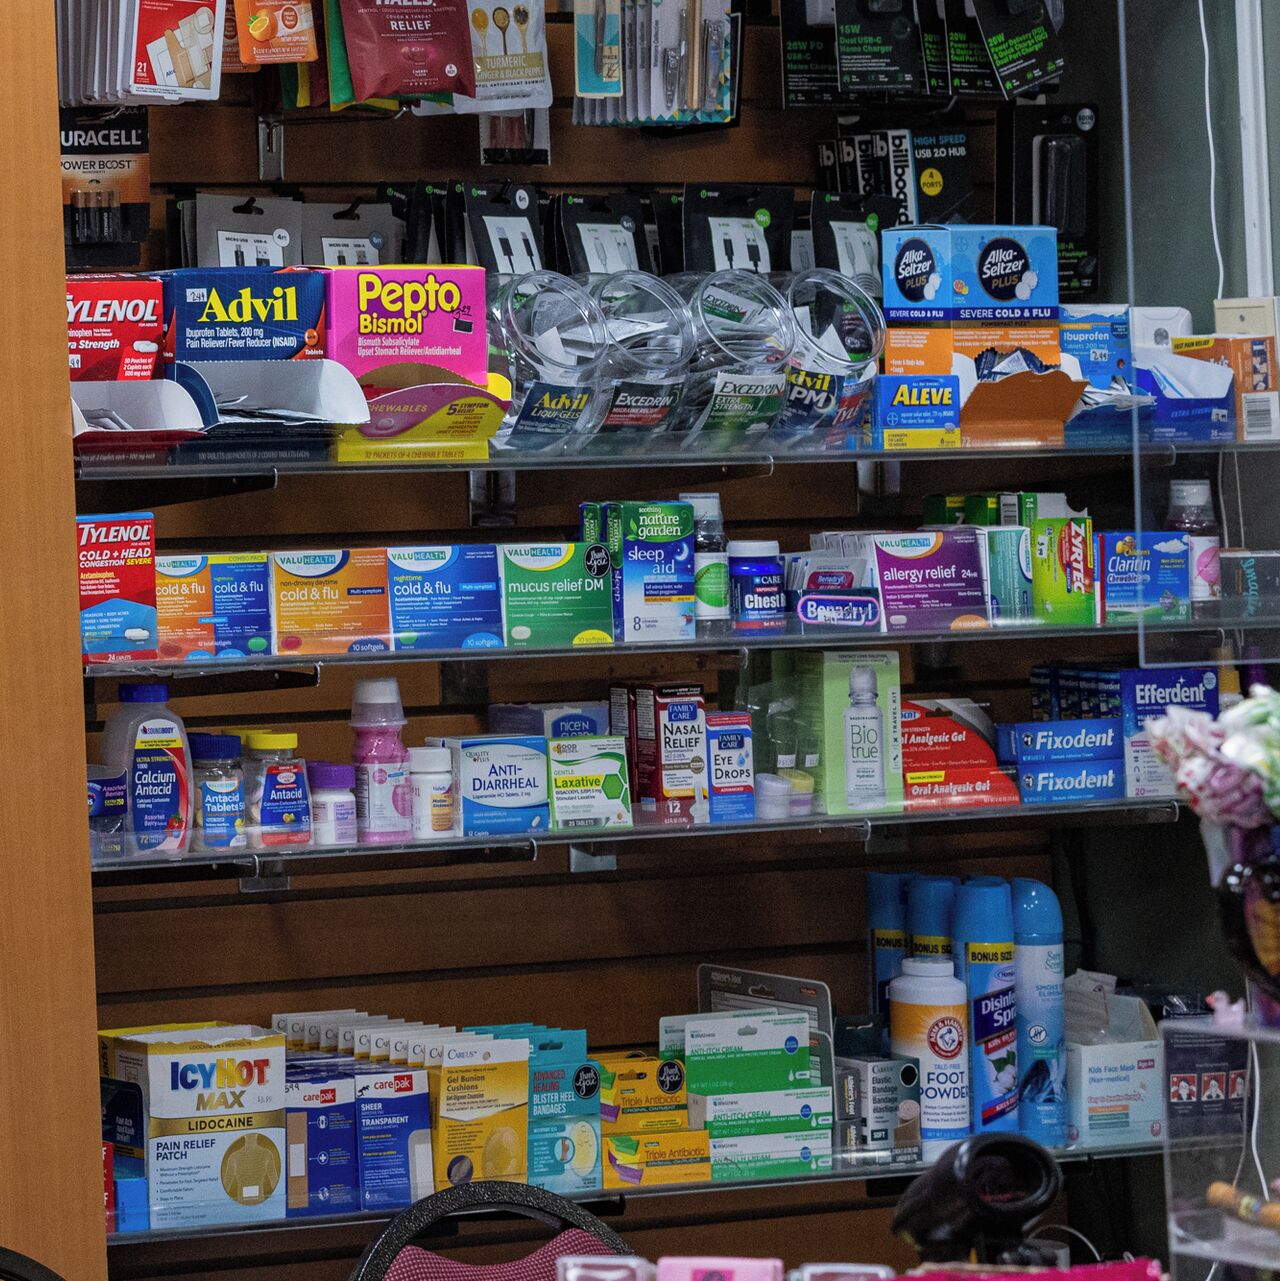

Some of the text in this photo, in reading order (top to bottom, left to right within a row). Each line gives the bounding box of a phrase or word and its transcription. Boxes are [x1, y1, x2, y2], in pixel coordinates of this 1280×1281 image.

[391, 21, 431, 30] RELIEF
[137, 63, 146, 71] 21
[898, 261, 932, 278] Seltzer
[982, 259, 1024, 277] Seltzer
[992, 276, 1019, 288] PLUS
[358, 273, 461, 318] Pepto
[198, 287, 297, 322] Advil
[960, 308, 1050, 318] SEVERE COLD & FLU
[359, 313, 423, 334] Bismol
[1064, 332, 1109, 342] Ibuprofen
[720, 382, 784, 394] EXCEDRIN
[537, 393, 589, 409] Advil
[791, 388, 828, 407] PM
[893, 385, 952, 406] ALEVE
[640, 514, 679, 525] nature
[79, 524, 150, 546] TYLENOL
[639, 526, 681, 537] garden
[628, 547, 663, 562] sleep
[653, 562, 675, 574] aid
[884, 565, 956, 582] allergy relief
[214, 582, 263, 593] cold & flu
[394, 581, 451, 595] cold & flu
[508, 578, 603, 592] mucus relief DM
[280, 587, 339, 601] cold & flu
[745, 594, 778, 609] Chest
[633, 617, 641, 631] 8
[1136, 683, 1206, 704] Efferdent
[663, 723, 703, 735] NASAL
[850, 725, 877, 744] Bio
[664, 737, 700, 748] RELIEF
[1036, 729, 1114, 750] Fixodent
[852, 746, 878, 759] true
[714, 754, 733, 766] EYE
[489, 763, 522, 777] ANTI-
[715, 768, 750, 779] DROPS
[135, 773, 175, 783] Calcium
[555, 778, 600, 788] Laxative
[1038, 771, 1115, 791] Fixodent
[136, 784, 171, 795] Antacid
[472, 778, 539, 791] DIARRHEAL
[205, 794, 239, 802] Antacid
[270, 789, 302, 799] Antacid
[205, 803, 238, 811] Tablets
[971, 951, 1012, 961] BONUS SIZE
[927, 1072, 964, 1085] FOOT
[196, 1091, 246, 1111] MAX
[533, 1092, 575, 1103] BLISTER HEEL
[361, 1103, 382, 1111] SHEER
[533, 1104, 566, 1114] BANDAGES
[188, 1117, 253, 1131] LIDOCAINE
[362, 1116, 408, 1125] TRANSPARENT
[156, 1139, 215, 1151] PAIN RELIEF
[156, 1152, 187, 1161] PATCH
